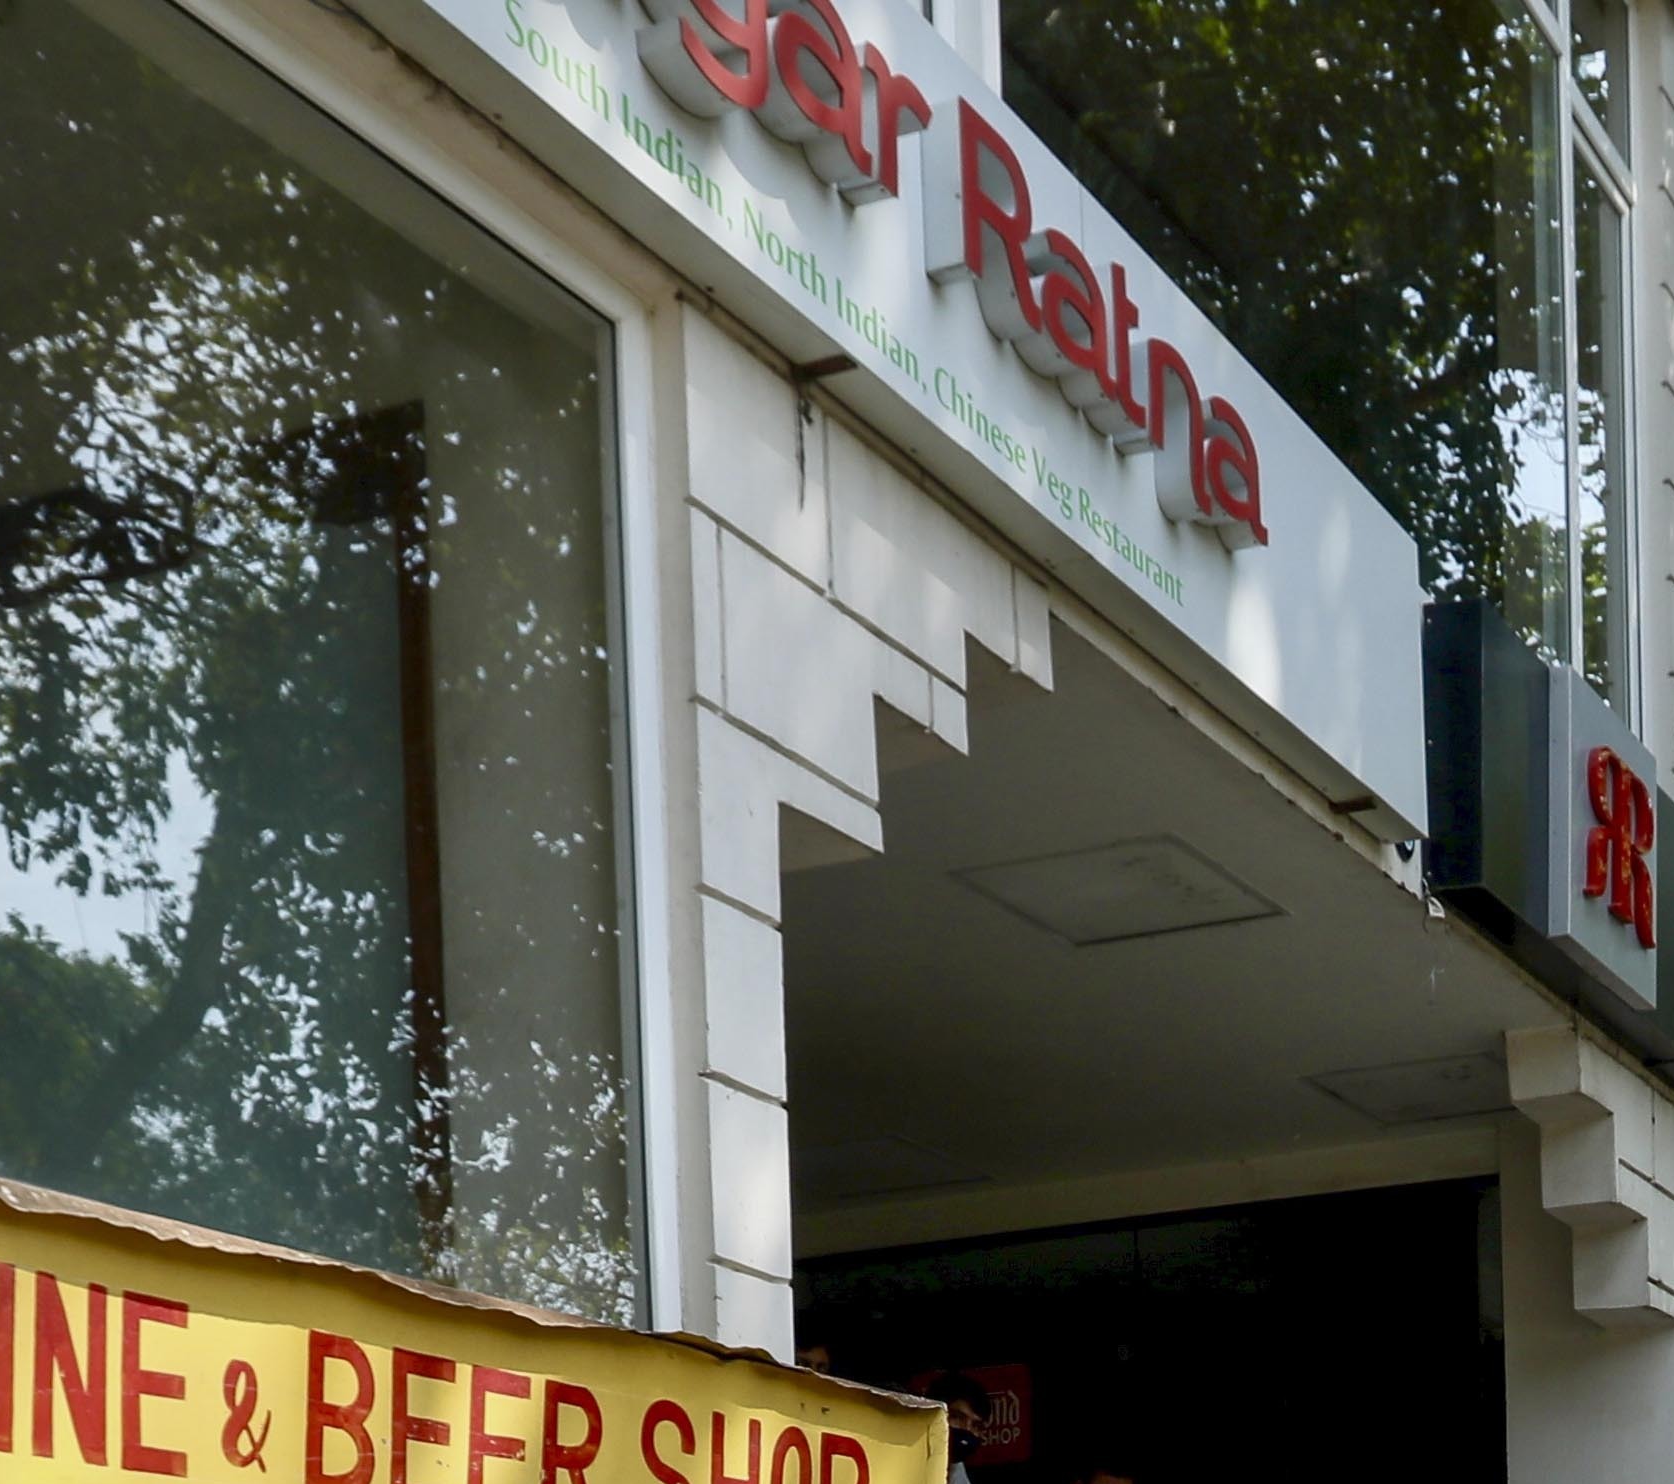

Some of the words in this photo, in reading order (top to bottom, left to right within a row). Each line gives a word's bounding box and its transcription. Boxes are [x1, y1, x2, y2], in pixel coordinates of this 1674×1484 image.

[506, 1, 610, 121] South
[622, 92, 733, 230] Indian,
[743, 197, 829, 305] North
[837, 276, 928, 393] Indian,
[934, 367, 1028, 473] Chinese
[1032, 448, 1072, 520] Veg
[1079, 488, 1184, 607] Restaurant
[959, 96, 1268, 547] Ratna
[221, 1359, 271, 1473] &
